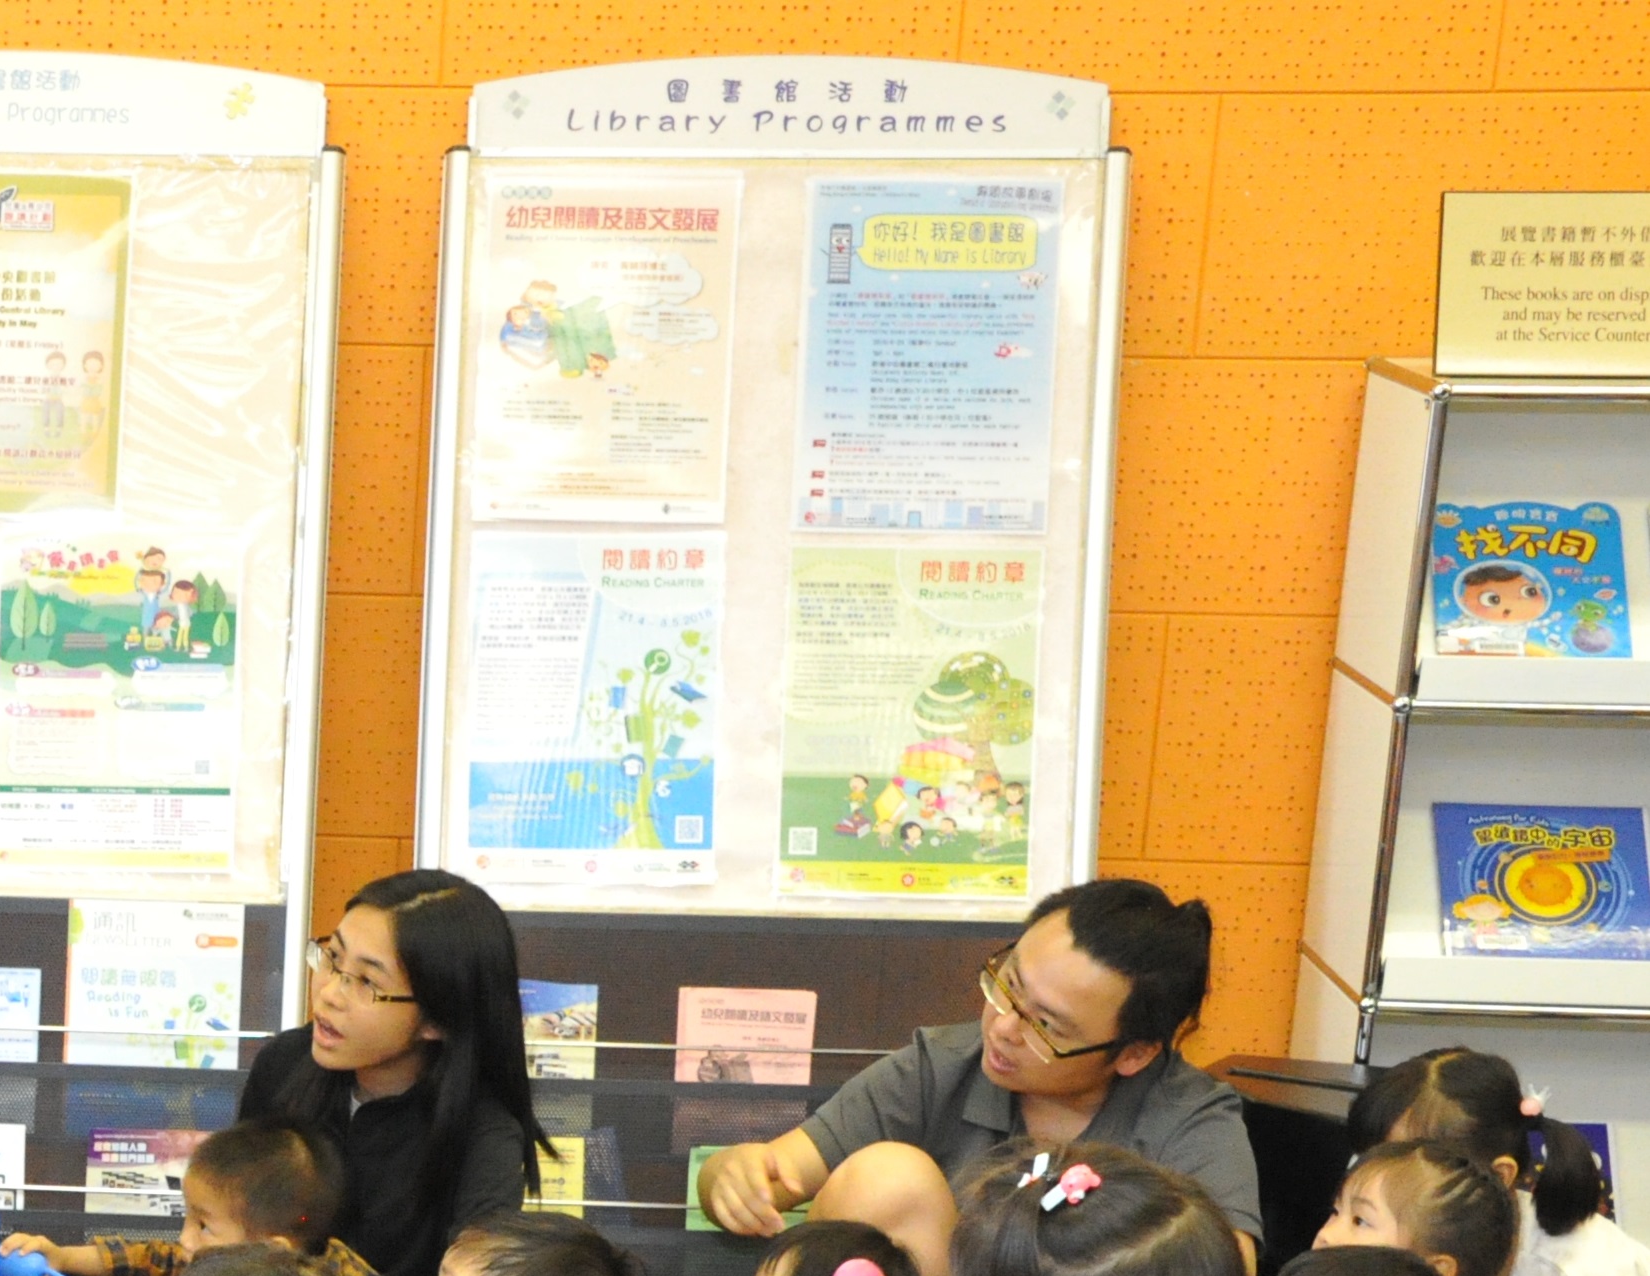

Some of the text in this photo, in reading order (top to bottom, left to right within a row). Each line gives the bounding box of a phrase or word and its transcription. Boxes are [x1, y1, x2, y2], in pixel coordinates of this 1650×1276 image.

[666, 78, 909, 104] 圖書館活動
[7, 102, 129, 127] Programmes
[567, 109, 1008, 136] Library Programmes
[506, 205, 719, 232] 幼兒閱讀及語文發展
[931, 222, 1026, 244] 我是圖書館
[873, 248, 910, 264] Hello!
[915, 249, 928, 265] My
[934, 249, 959, 264] Name
[982, 249, 1027, 266] Library
[1481, 286, 1522, 301] These
[1527, 286, 1568, 301] books
[1572, 290, 1593, 301] are
[1598, 290, 1615, 301] on
[0, 305, 31, 314] Central
[34, 306, 65, 316] Library
[1502, 308, 1647, 325] and may be reserved
[1496, 330, 1508, 341] at
[1513, 328, 1534, 341] the
[1538, 327, 1590, 341] Service
[1455, 524, 1597, 565] 找不同
[602, 548, 706, 571] 閱讀約章
[920, 560, 1027, 584] 閱讀約章
[602, 576, 705, 589] READING CHARTER
[919, 588, 1024, 601] READING CHARTER
[617, 610, 646, 626] 21.4
[659, 608, 714, 628] 8.5.2018
[935, 623, 963, 639] 21.4
[1473, 824, 1615, 850] 望遠鏡中的宇宙
[87, 990, 141, 1005] Reading
[126, 1006, 149, 1018] Fun
